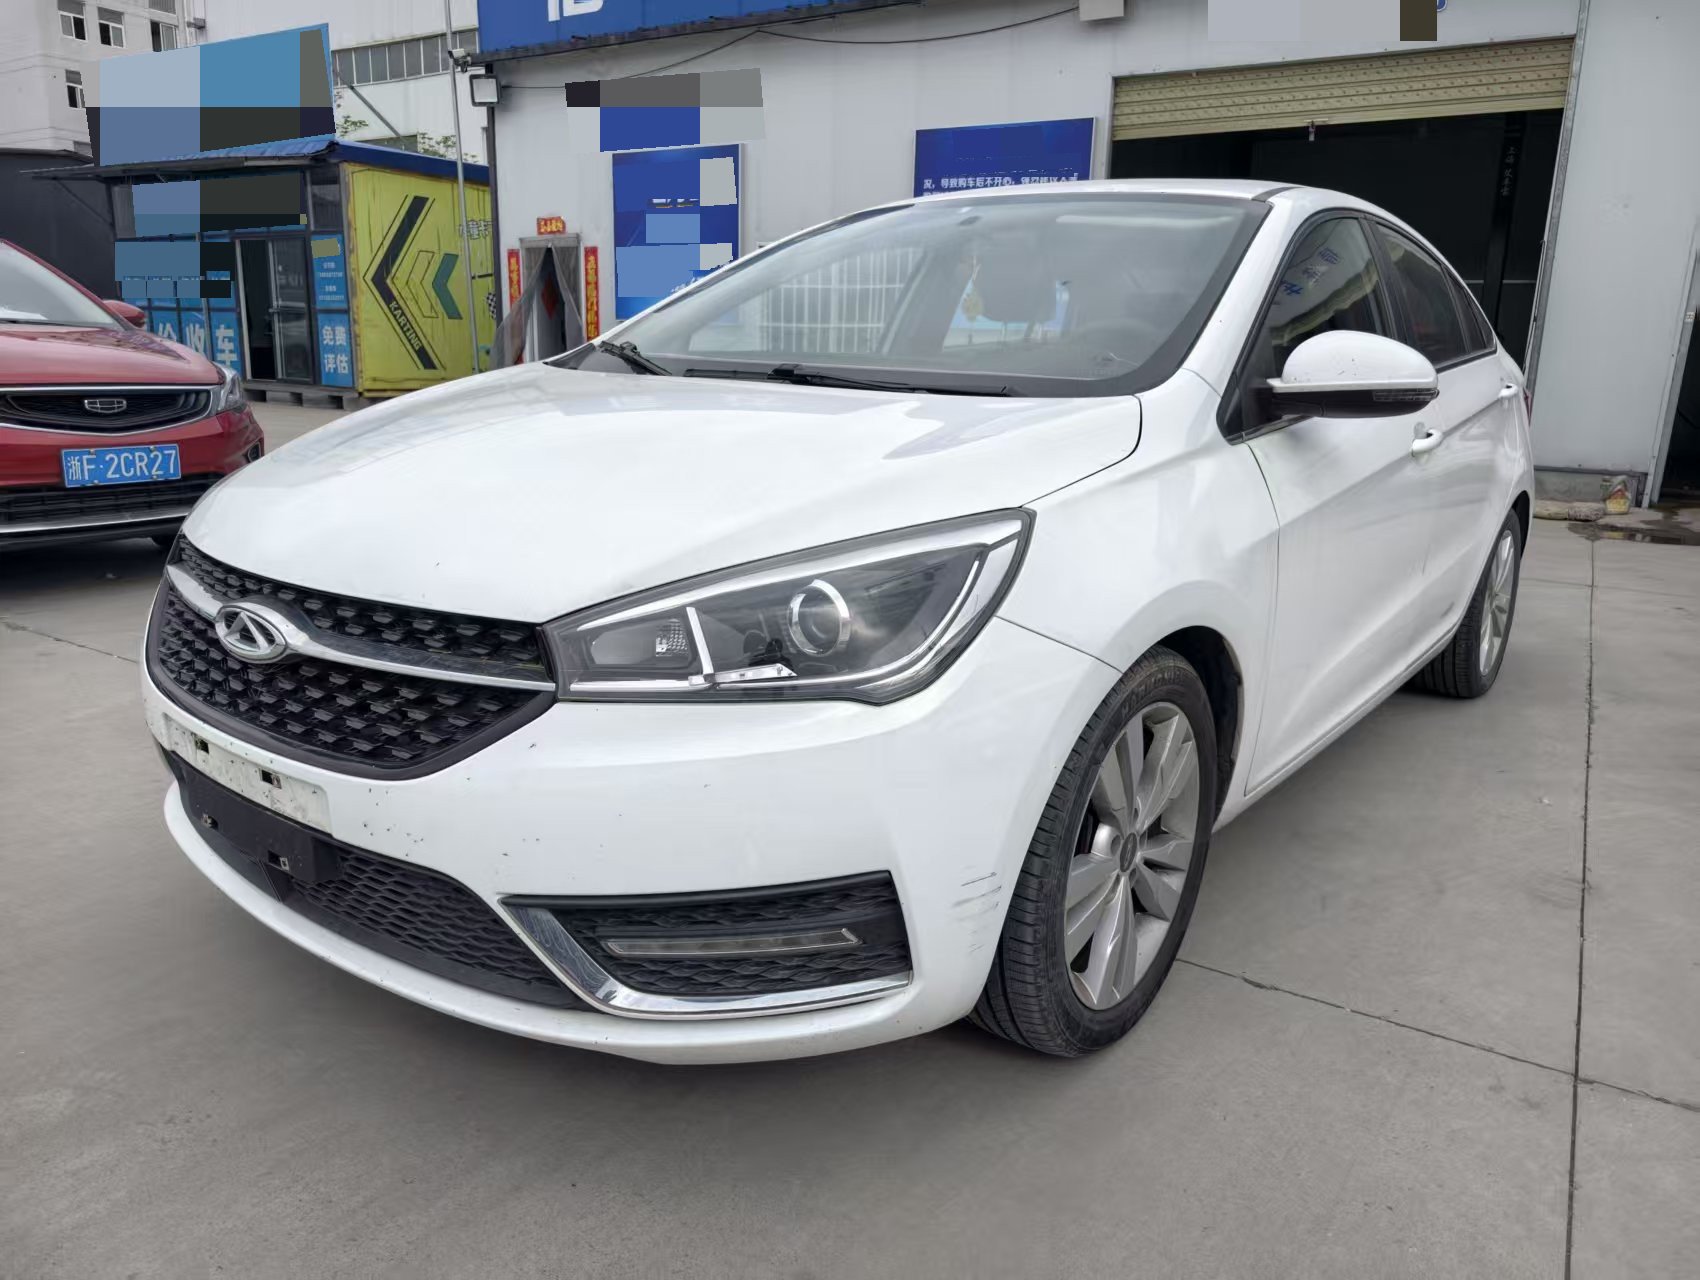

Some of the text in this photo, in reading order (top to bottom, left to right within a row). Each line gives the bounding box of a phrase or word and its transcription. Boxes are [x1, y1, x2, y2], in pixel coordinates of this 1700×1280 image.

[322, 325, 347, 345] 免费
[388, 301, 422, 351] KARTING
[324, 353, 349, 374] 评估
